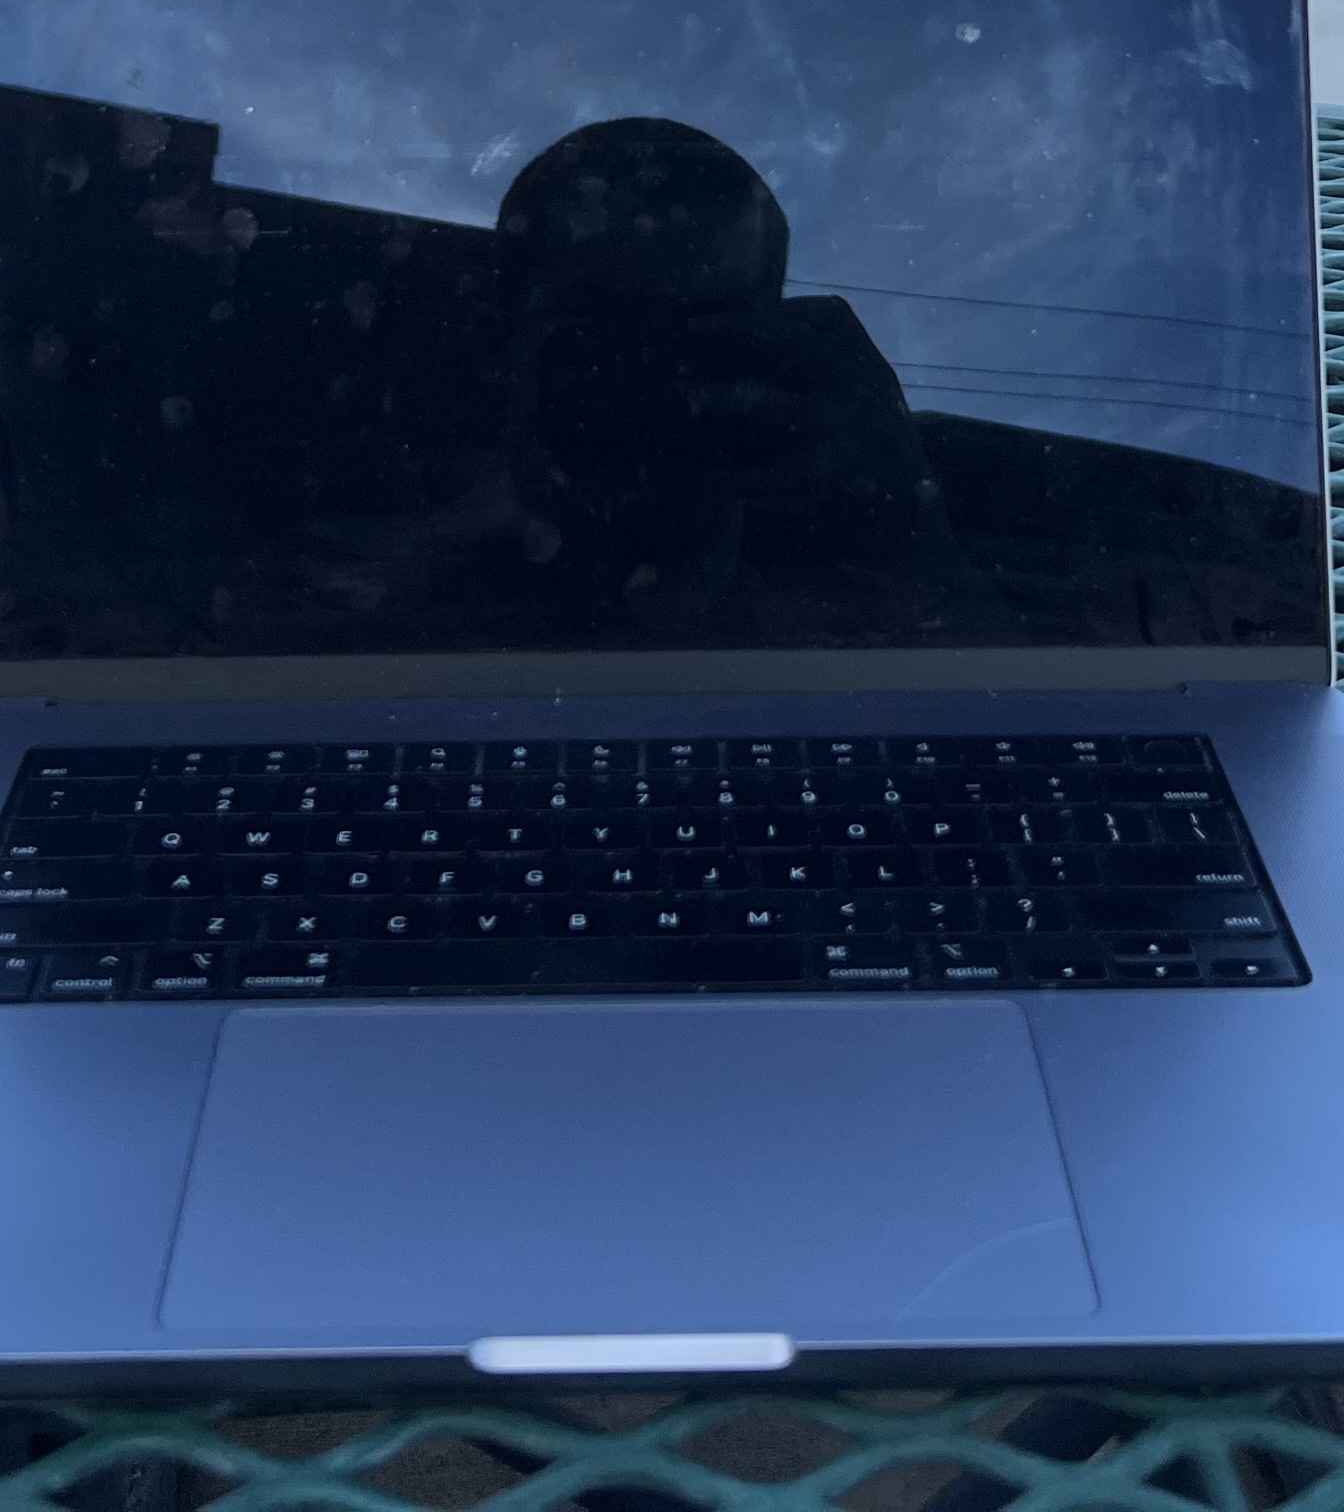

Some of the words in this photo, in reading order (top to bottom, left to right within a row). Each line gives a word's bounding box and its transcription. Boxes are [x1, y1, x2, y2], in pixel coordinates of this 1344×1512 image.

[134, 801, 144, 811] 1
[216, 799, 231, 810] 2
[301, 798, 315, 811] 3
[383, 797, 398, 810] 4
[468, 796, 483, 809] 5
[550, 794, 566, 808] 6
[636, 793, 648, 805] 7
[718, 792, 733, 805] 8
[801, 791, 816, 805] 9
[884, 791, 900, 803] 0
[161, 832, 181, 847] Q
[246, 831, 271, 845] W
[336, 830, 352, 845] E
[421, 829, 439, 844] R
[508, 828, 523, 842] T
[593, 827, 608, 841] Y
[676, 825, 696, 840] U
[767, 824, 775, 838] I
[847, 823, 866, 838] O
[934, 822, 950, 837] P
[172, 874, 191, 889] A
[262, 872, 279, 887] S
[349, 871, 369, 887] D
[439, 870, 454, 885] F
[525, 869, 544, 885] G
[612, 868, 633, 883] H
[703, 867, 718, 881] J
[789, 866, 806, 880] K
[877, 865, 893, 880] L
[207, 917, 225, 933] Z
[298, 916, 316, 933] X
[387, 915, 406, 932] C
[479, 915, 497, 931] V
[569, 913, 587, 929] B
[658, 912, 679, 928] N
[747, 910, 770, 926] M
[52, 977, 113, 989] control
[153, 976, 208, 989] option
[244, 974, 326, 987] command
[829, 966, 910, 978] command
[946, 966, 999, 978] option
